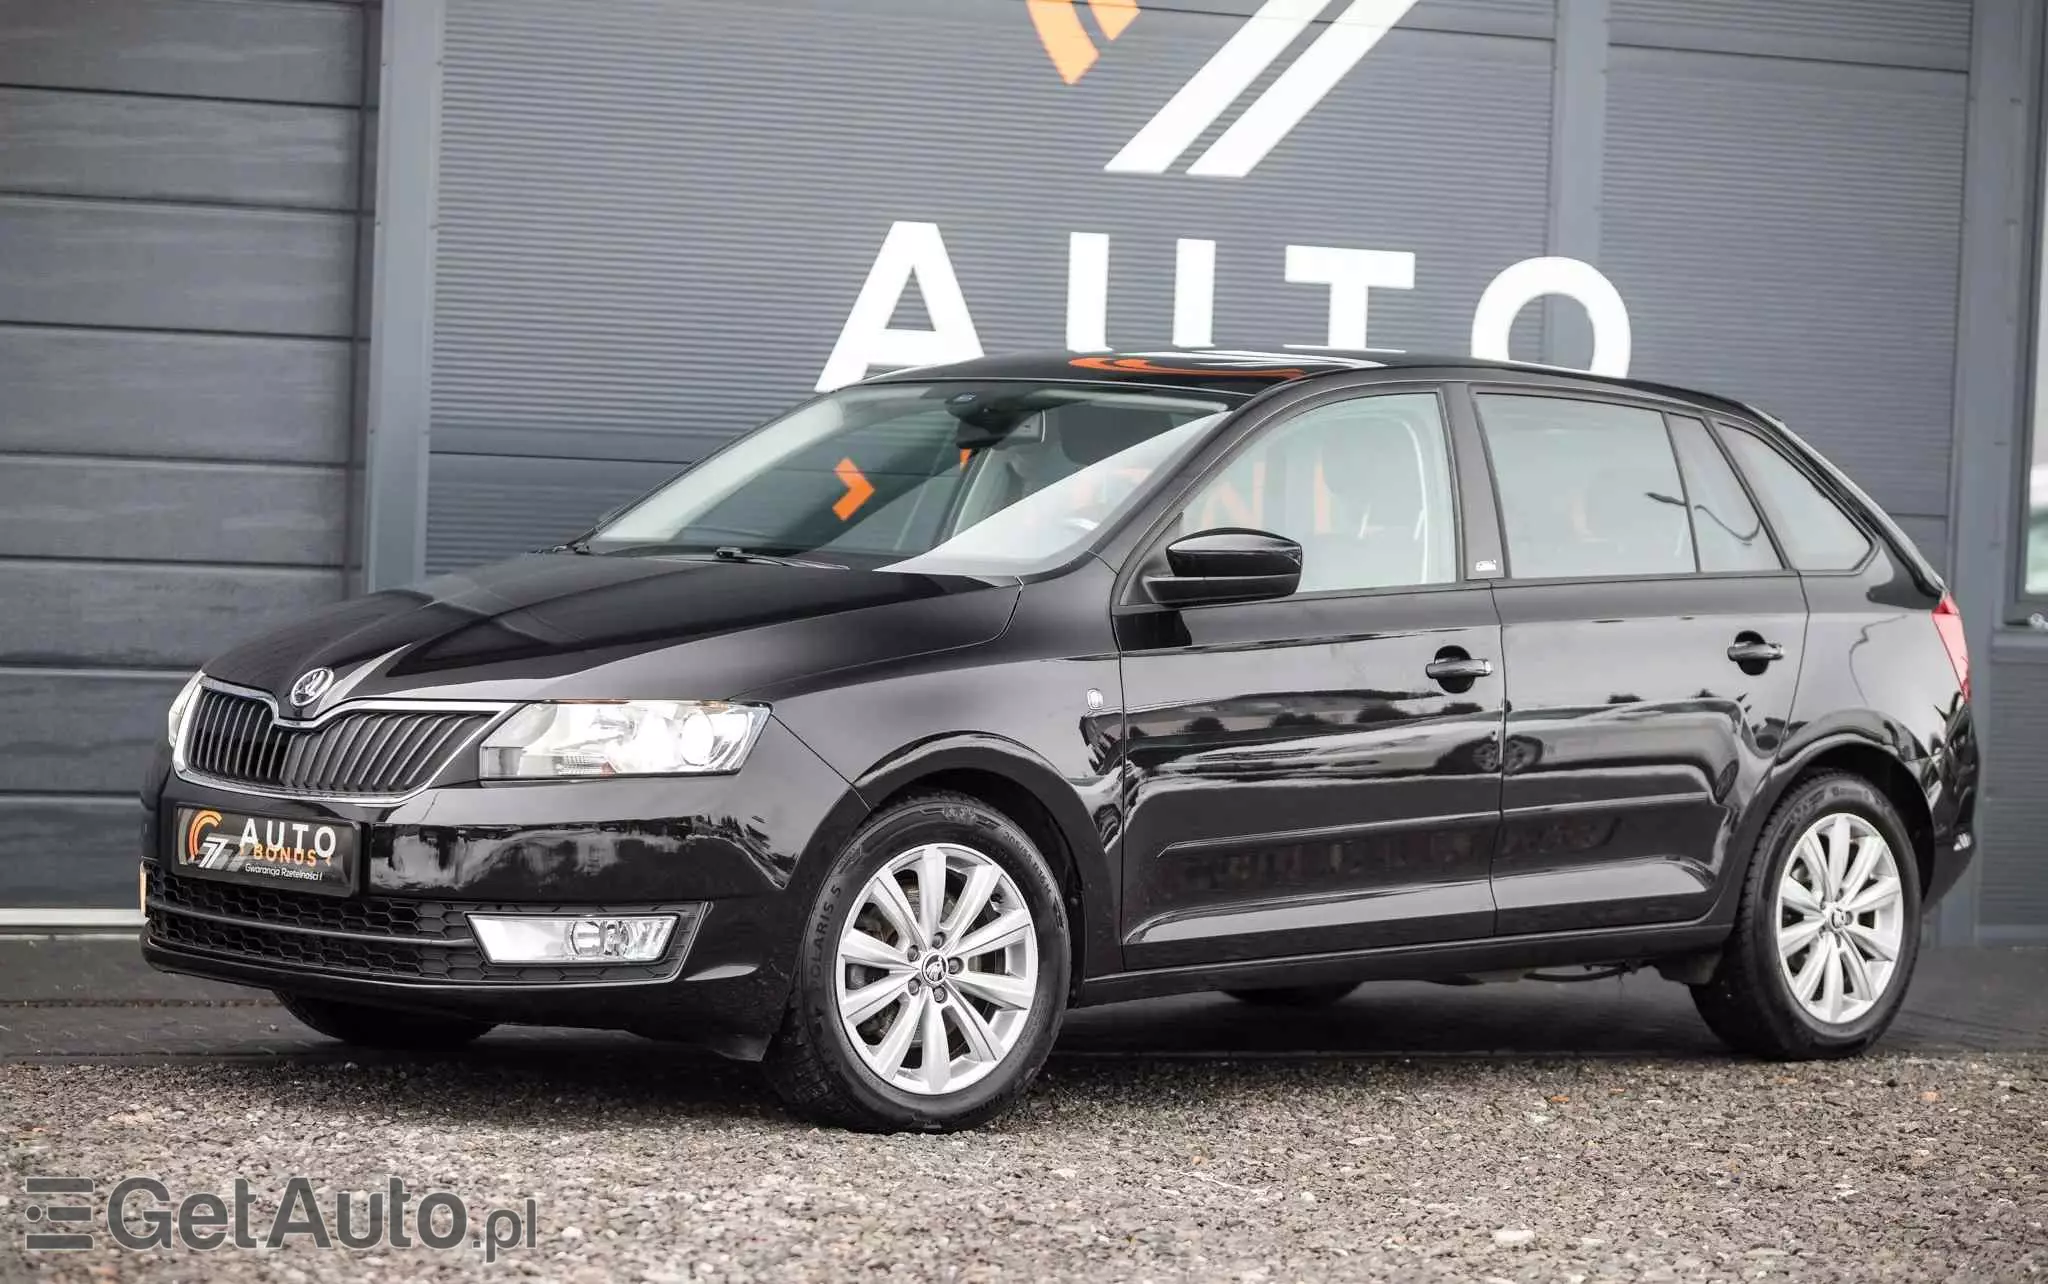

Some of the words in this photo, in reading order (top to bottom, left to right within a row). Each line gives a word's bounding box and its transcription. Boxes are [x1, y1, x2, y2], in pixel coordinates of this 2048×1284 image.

[815, 220, 1632, 393] AUTO
[239, 818, 336, 858] AUTO
[253, 843, 317, 867] BONUS
